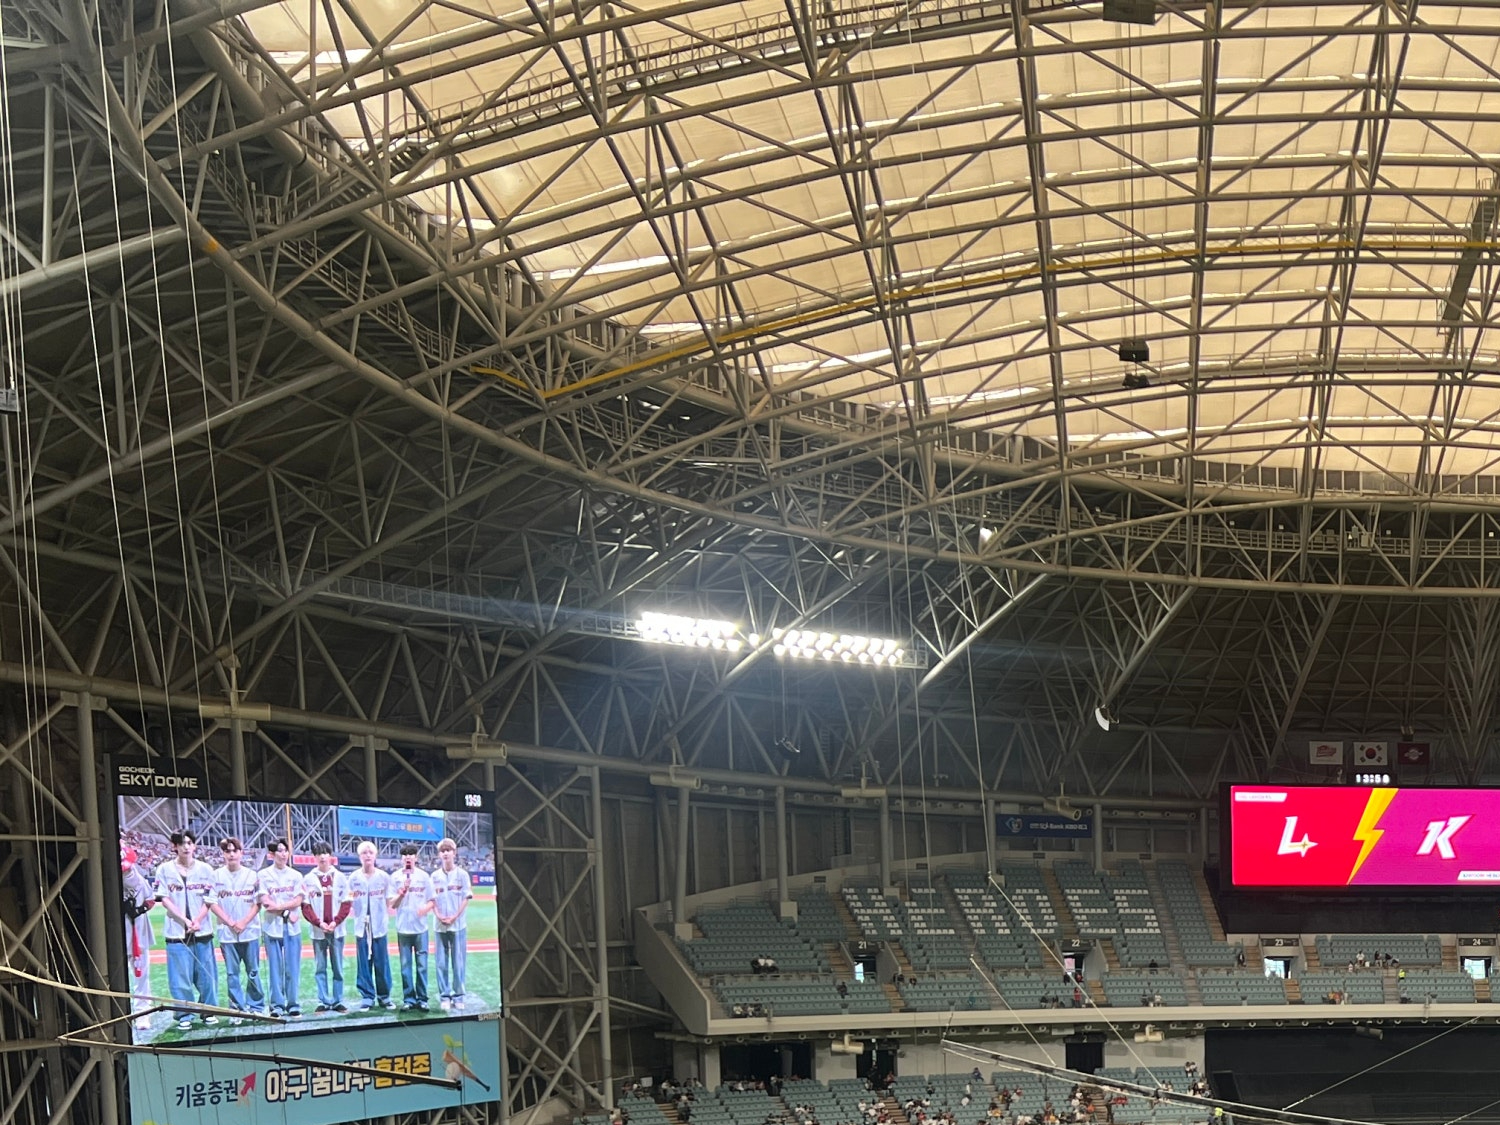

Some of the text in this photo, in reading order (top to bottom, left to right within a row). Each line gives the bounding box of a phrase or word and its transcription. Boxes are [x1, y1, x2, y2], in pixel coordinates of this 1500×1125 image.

[119, 766, 155, 774] GOCHEOK
[119, 773, 198, 788] SKY DOME
[176, 1078, 238, 1107] 키움증권
[266, 1068, 309, 1101] 야구
